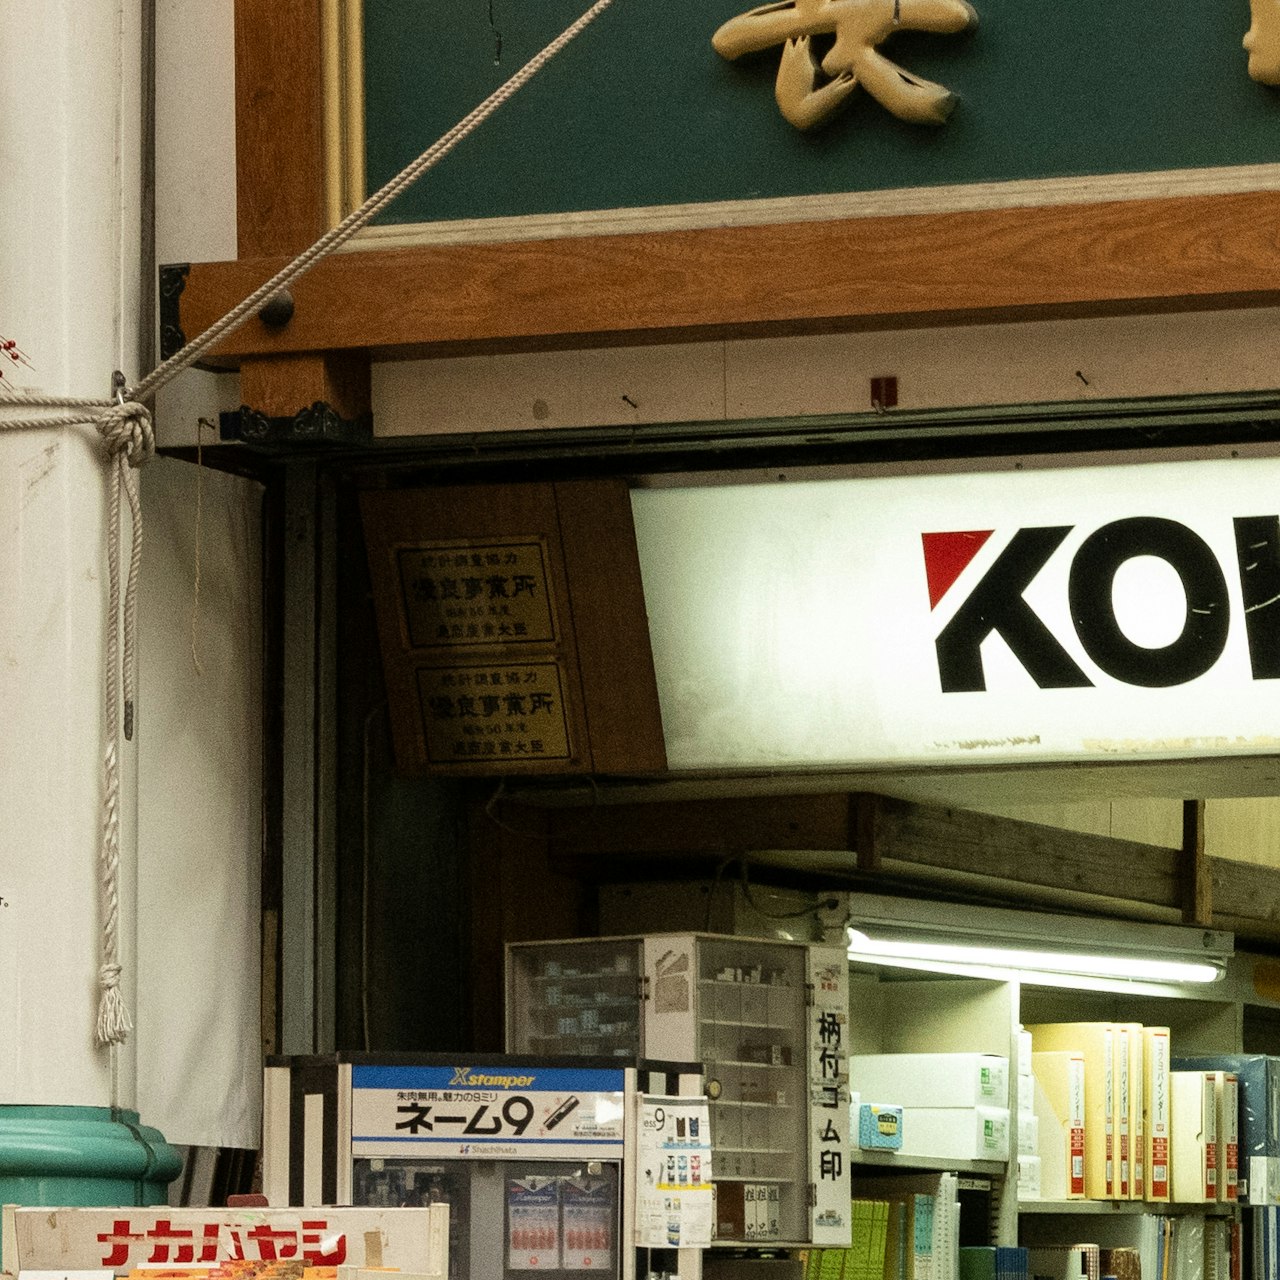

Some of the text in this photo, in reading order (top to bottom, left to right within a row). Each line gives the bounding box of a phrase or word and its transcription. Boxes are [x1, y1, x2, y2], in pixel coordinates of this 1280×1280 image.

[449, 1067, 536, 1090] Xstamper
[819, 1012, 842, 1181] 柄付ゴム印
[395, 1096, 534, 1136] ネーム9
[472, 1145, 517, 1154] Shachihata
